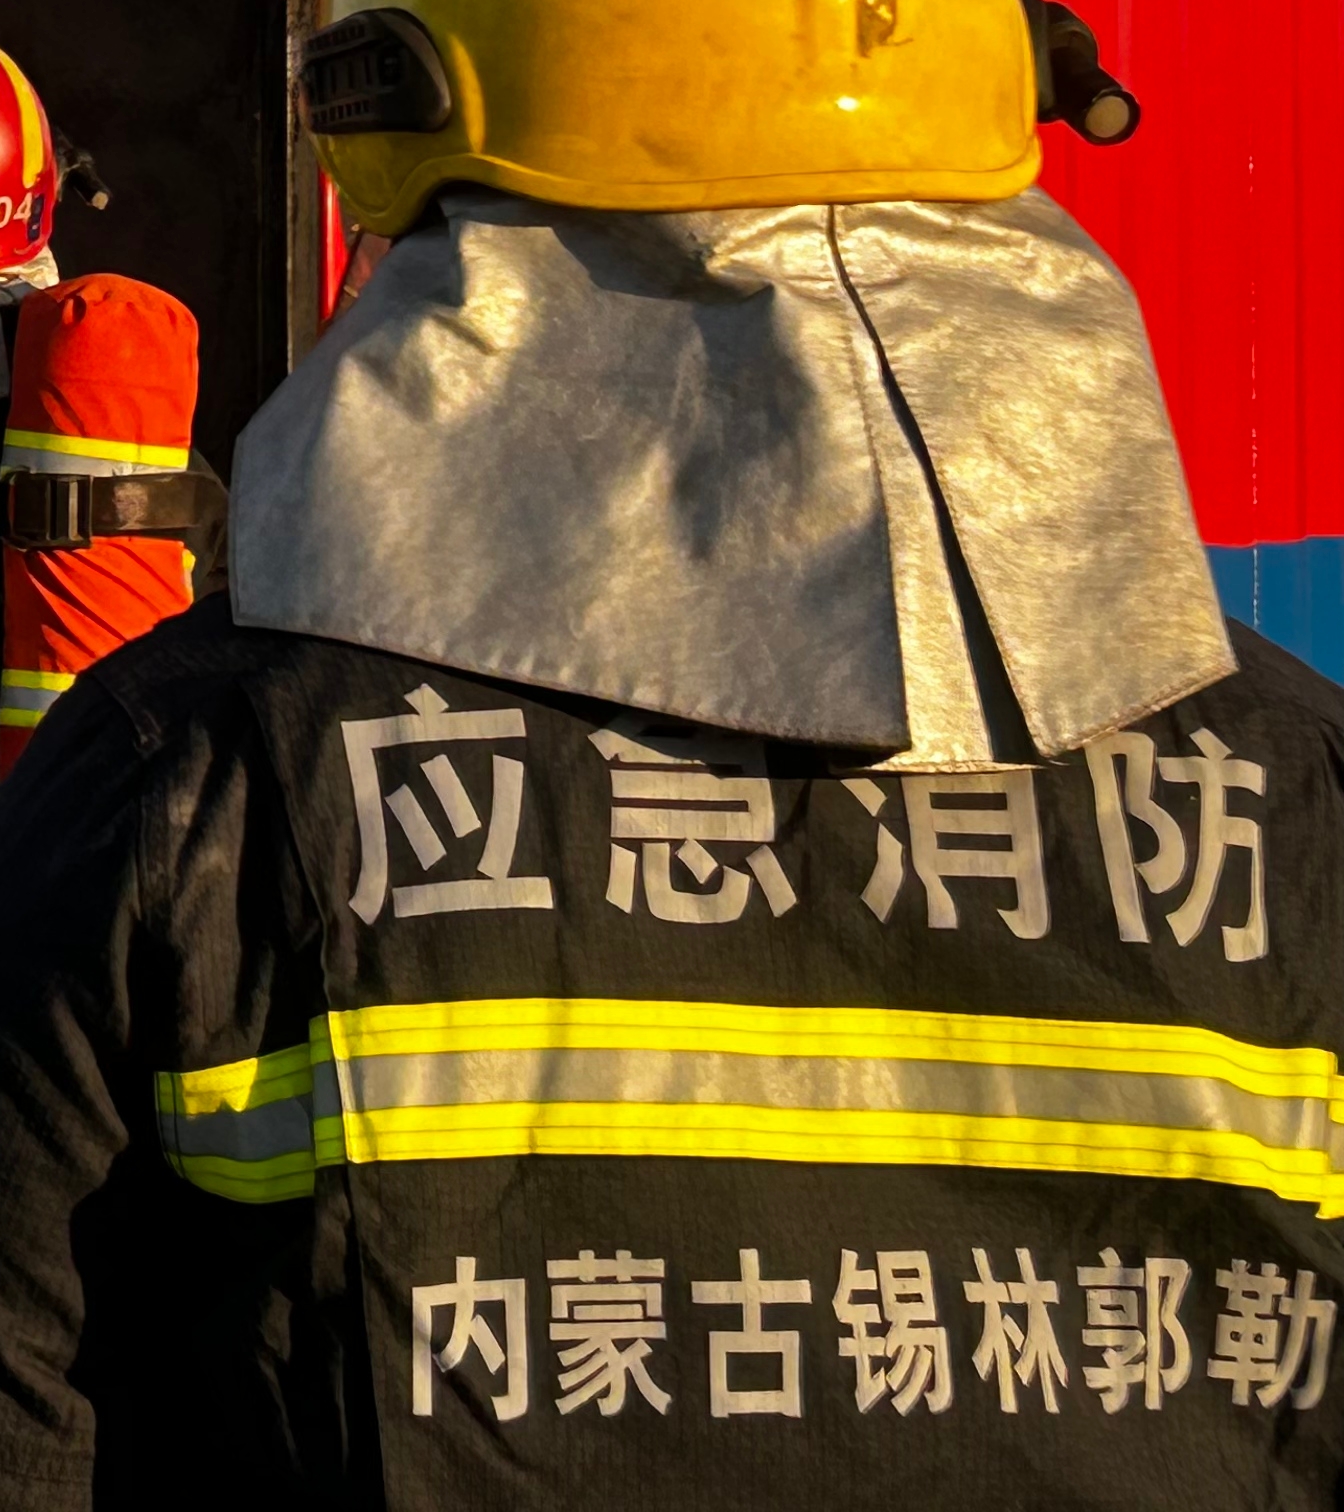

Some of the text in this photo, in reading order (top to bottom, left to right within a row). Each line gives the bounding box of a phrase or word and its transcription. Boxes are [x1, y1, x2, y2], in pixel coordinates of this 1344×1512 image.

[341, 683, 1268, 962] 应急消防
[411, 1246, 1339, 1422] 内蒙古锡林郭勒
